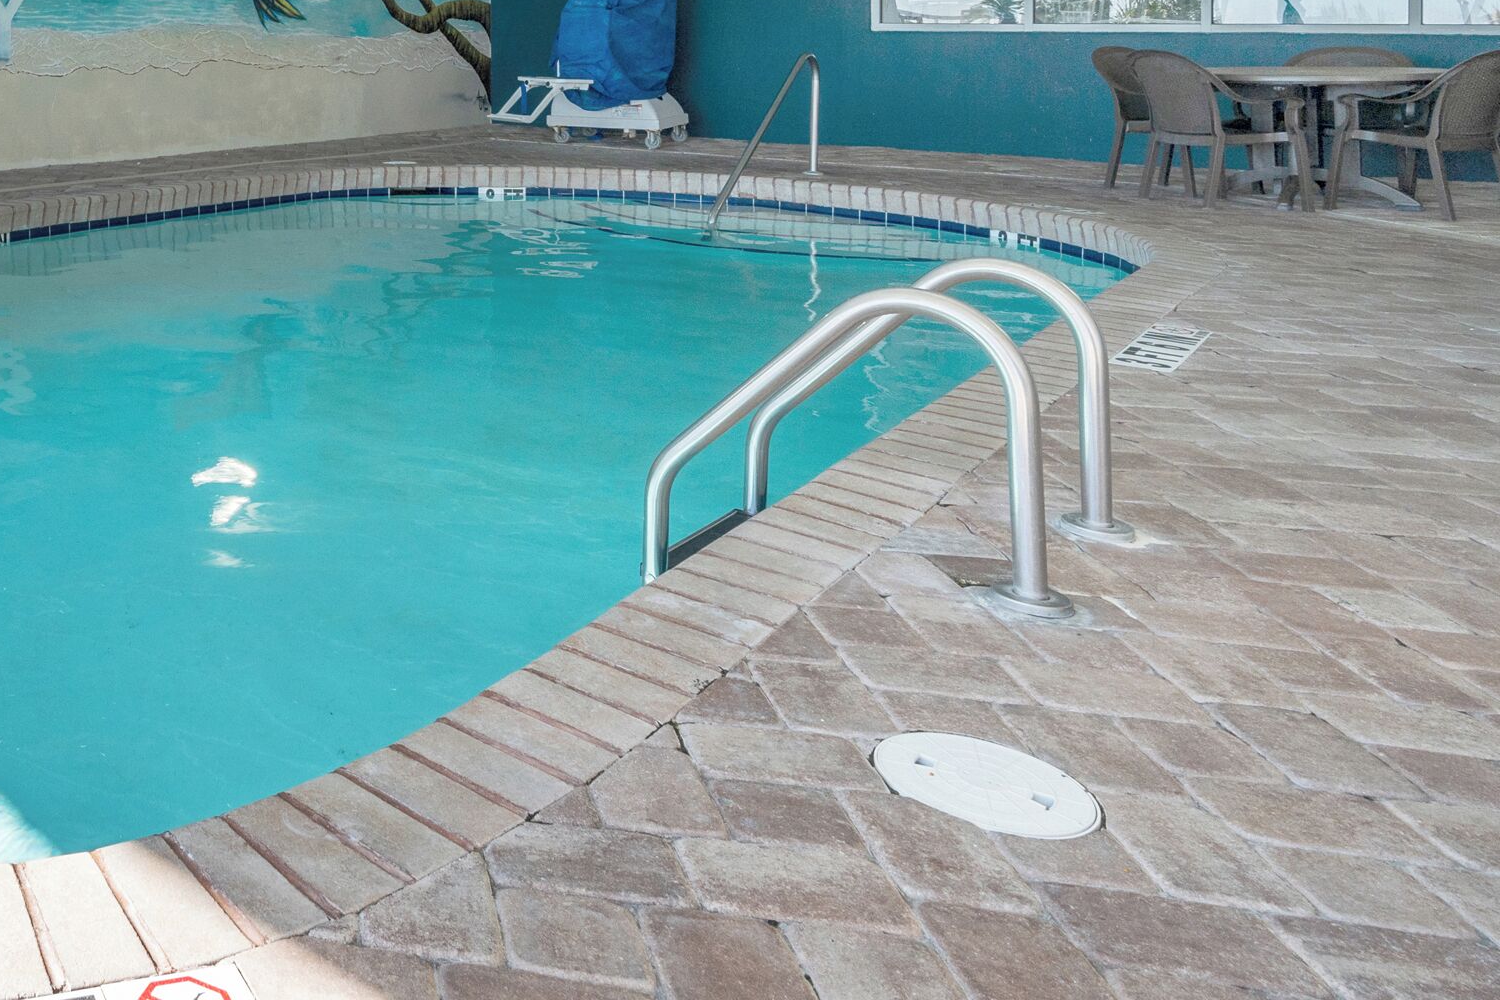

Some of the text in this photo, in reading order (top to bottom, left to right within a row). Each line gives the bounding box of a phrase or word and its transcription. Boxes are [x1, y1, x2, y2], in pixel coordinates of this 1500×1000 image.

[1140, 330, 1201, 346] IN
[1121, 345, 1185, 363] FT
[1114, 357, 1173, 369] 3
